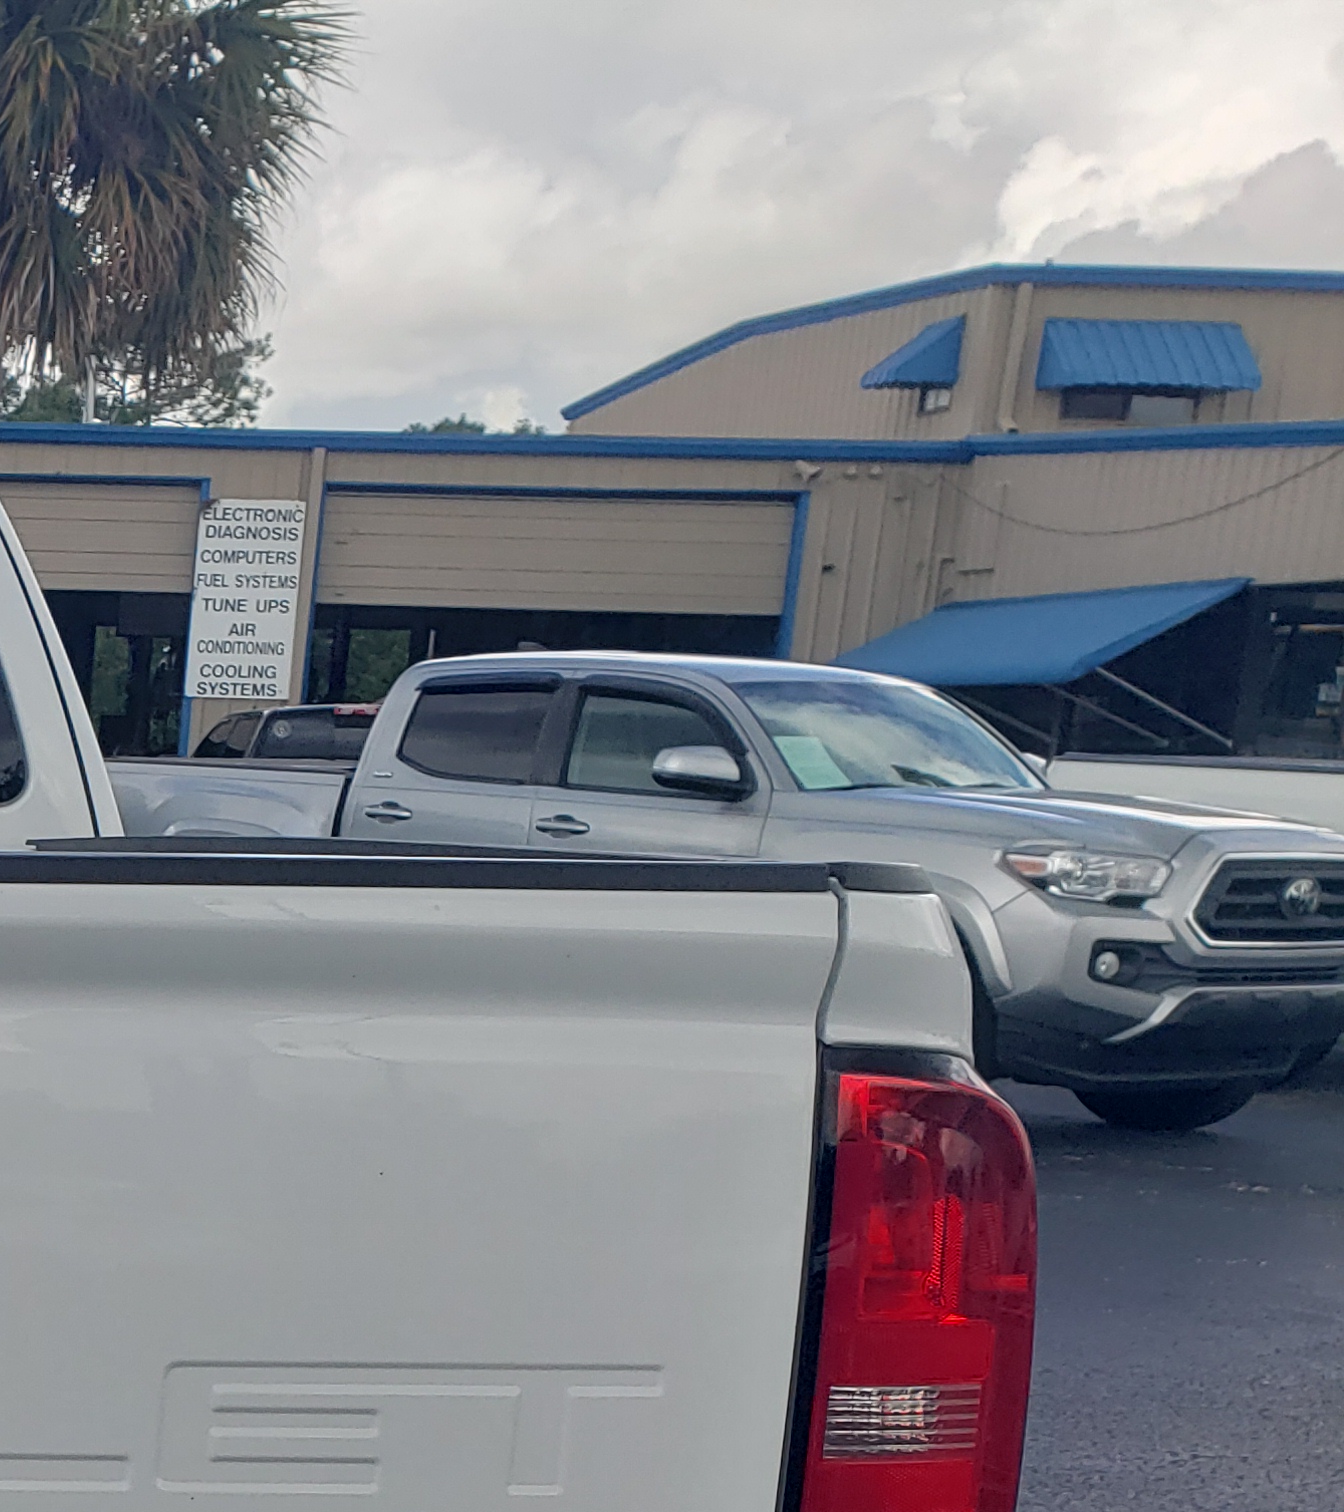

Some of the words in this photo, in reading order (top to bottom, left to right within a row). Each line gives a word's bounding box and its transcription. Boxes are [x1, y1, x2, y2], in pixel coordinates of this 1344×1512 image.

[202, 507, 304, 523] ELECTRONIC
[205, 525, 299, 541] DIAGNOSIS
[200, 550, 297, 565] COMPUTERS
[196, 574, 229, 588] FUEL
[235, 575, 297, 589] SYSTEMS
[202, 598, 248, 612] TUNE
[255, 600, 290, 614] UPS
[228, 623, 256, 637] AIR
[197, 640, 285, 656] CONDITIONING
[199, 664, 277, 679] COOLING
[196, 682, 277, 697] SYSTEMS
